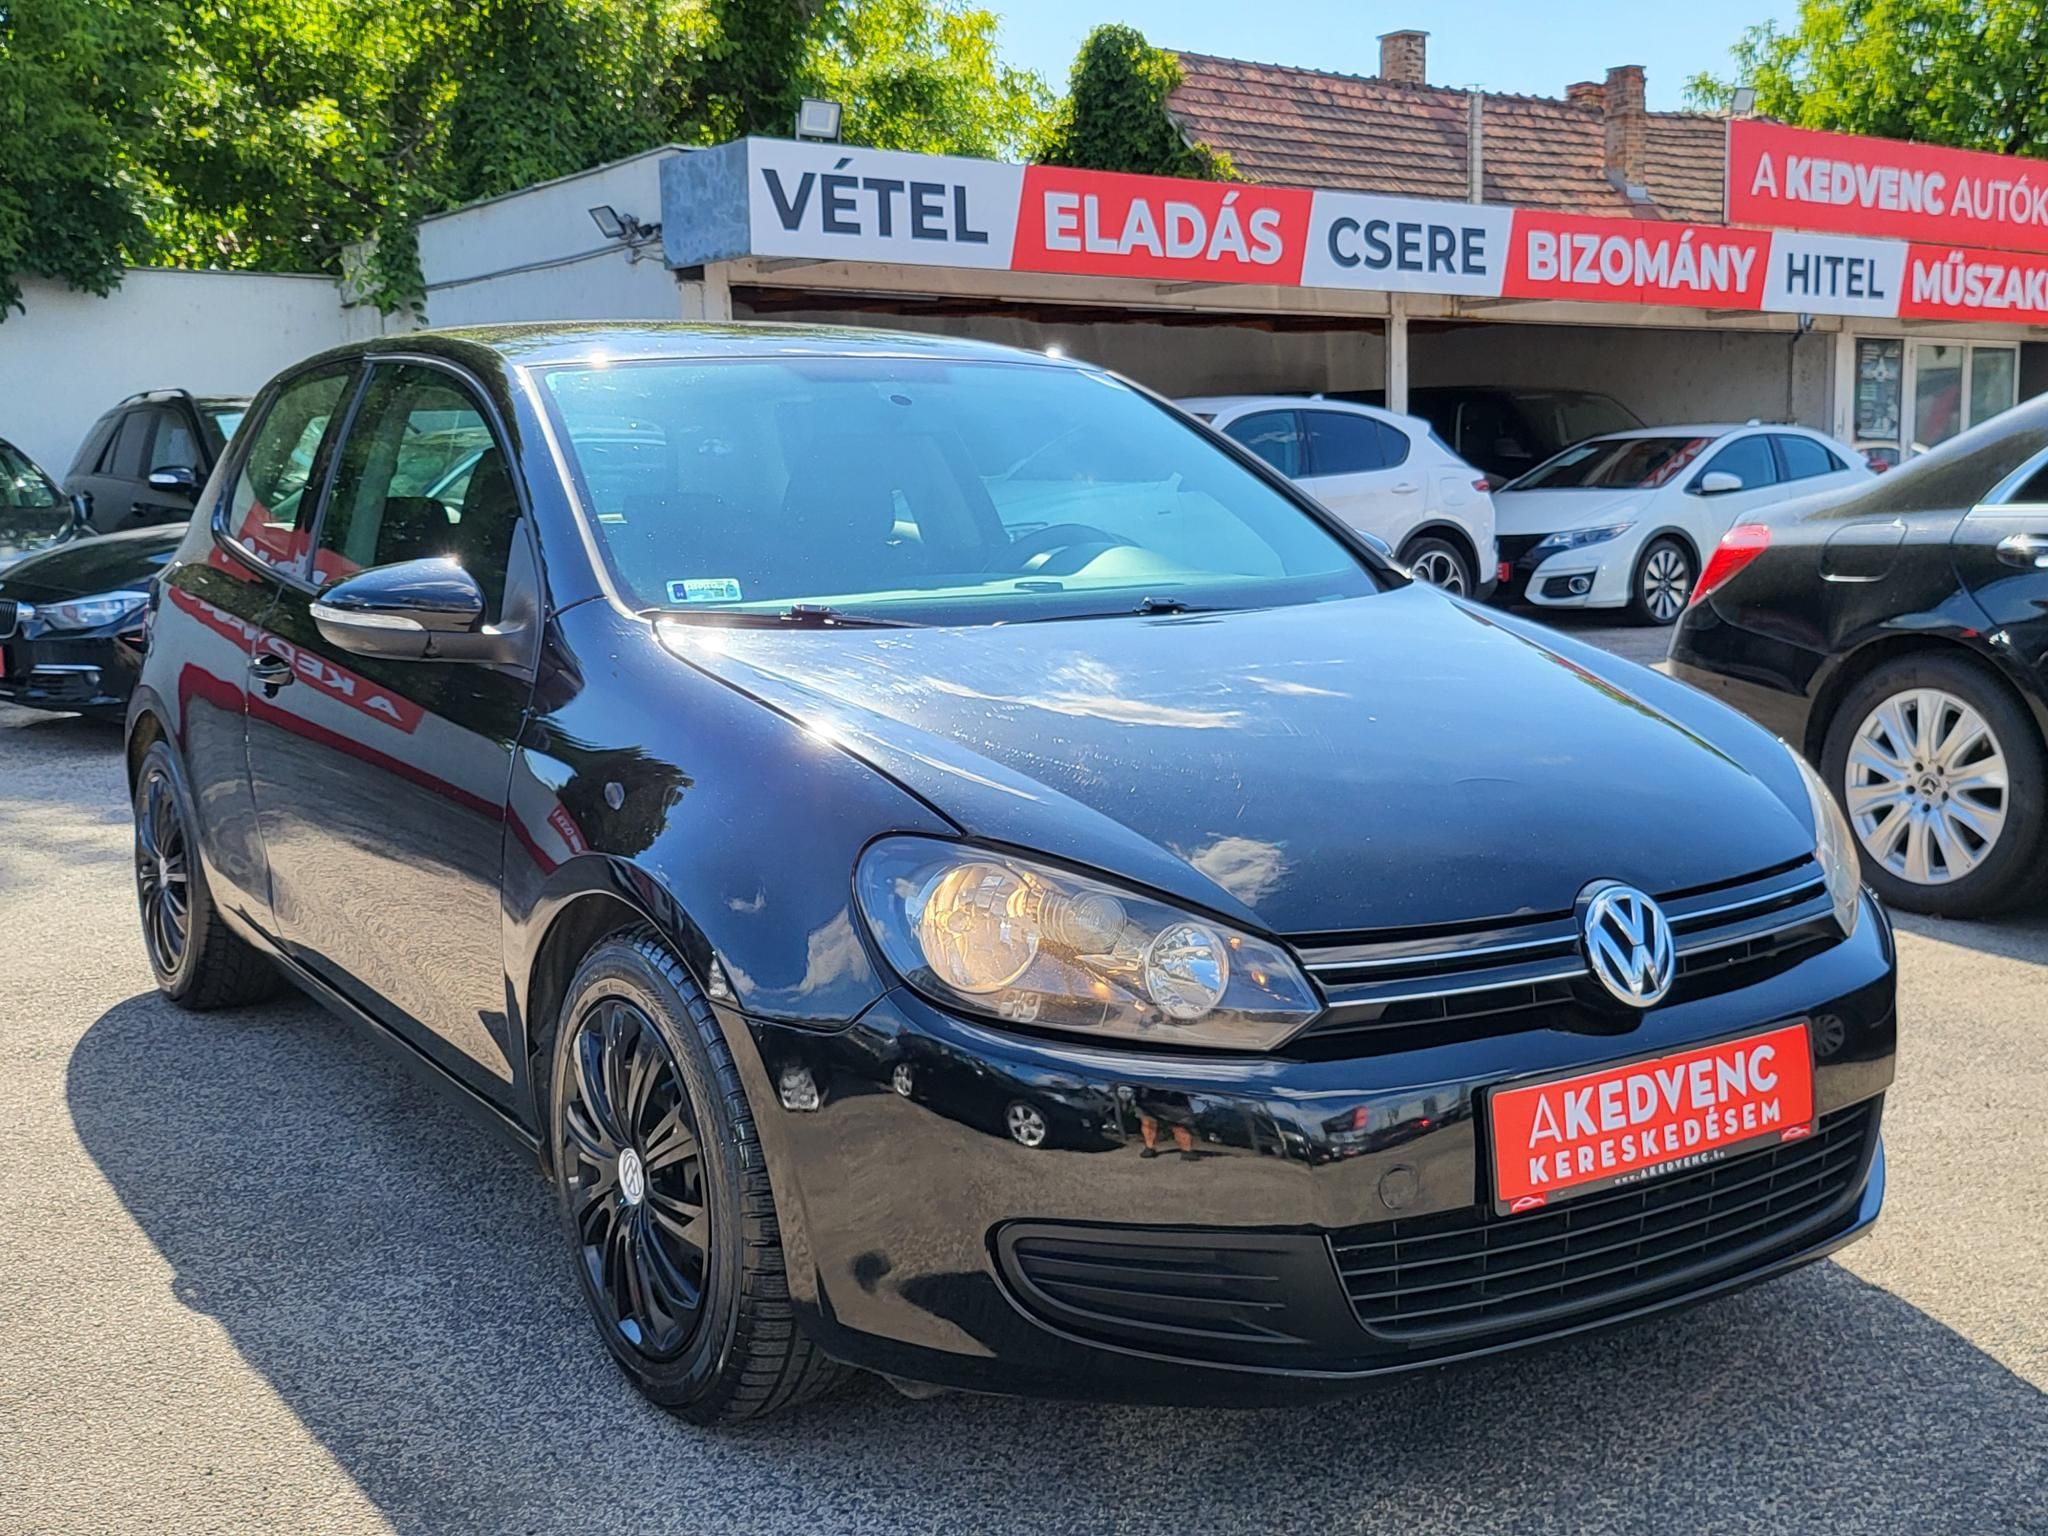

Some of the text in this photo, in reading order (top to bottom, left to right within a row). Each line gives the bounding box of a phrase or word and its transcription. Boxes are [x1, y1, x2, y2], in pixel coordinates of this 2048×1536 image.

[761, 157, 989, 245] VÉTEL
[1751, 151, 1778, 198] A
[1785, 155, 1946, 216] KEDVENC
[1043, 191, 1283, 265] ELADÁS
[1327, 216, 1487, 276] CSERE
[1527, 229, 1757, 293] BIZOMÁNY
[1786, 252, 1885, 299] HITEL
[1911, 250, 2048, 312] MŰSZAK
[1529, 1097, 1782, 1185] KERESKEDÉSEM
